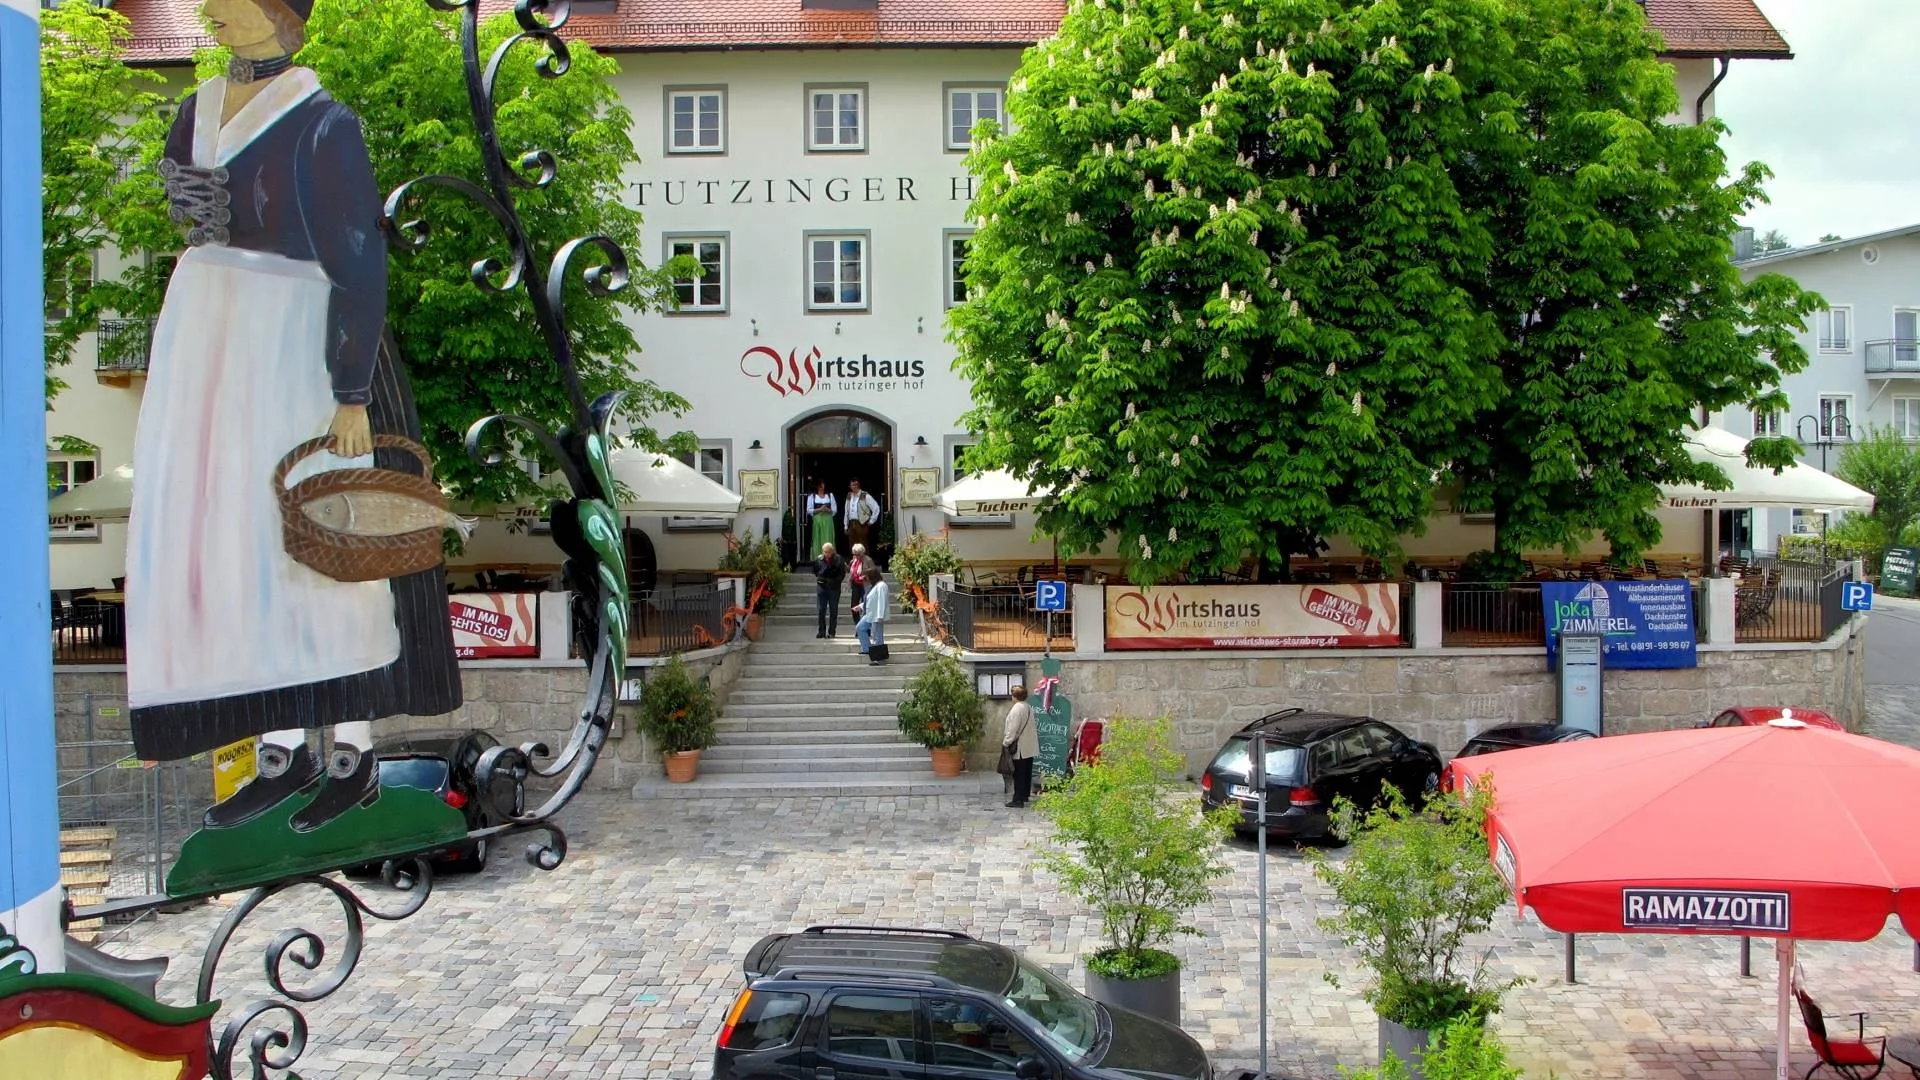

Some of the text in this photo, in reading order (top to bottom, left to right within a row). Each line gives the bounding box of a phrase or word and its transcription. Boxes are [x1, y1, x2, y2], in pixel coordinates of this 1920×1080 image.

[630, 177, 918, 205] TUTZINGER
[741, 345, 925, 397] Wirtshaus
[817, 379, 925, 392] im tutzinger hof
[976, 501, 1028, 513] Tucher
[1669, 496, 1717, 508] Tucher
[1040, 584, 1057, 607] P
[1323, 594, 1360, 616] IM MAI
[1849, 585, 1866, 607] P
[462, 606, 500, 626] IM MAI
[1115, 591, 1261, 632] Wirtshaus
[1308, 602, 1342, 622] GEHTS
[1640, 603, 1687, 611] Innenausbau
[483, 625, 508, 640] LOS!
[1176, 618, 1261, 630] im tutzinger hof
[1213, 636, 1339, 647] www.wirtshaus-starnberg.de
[1629, 895, 1782, 926] RAMAZZOTTI
